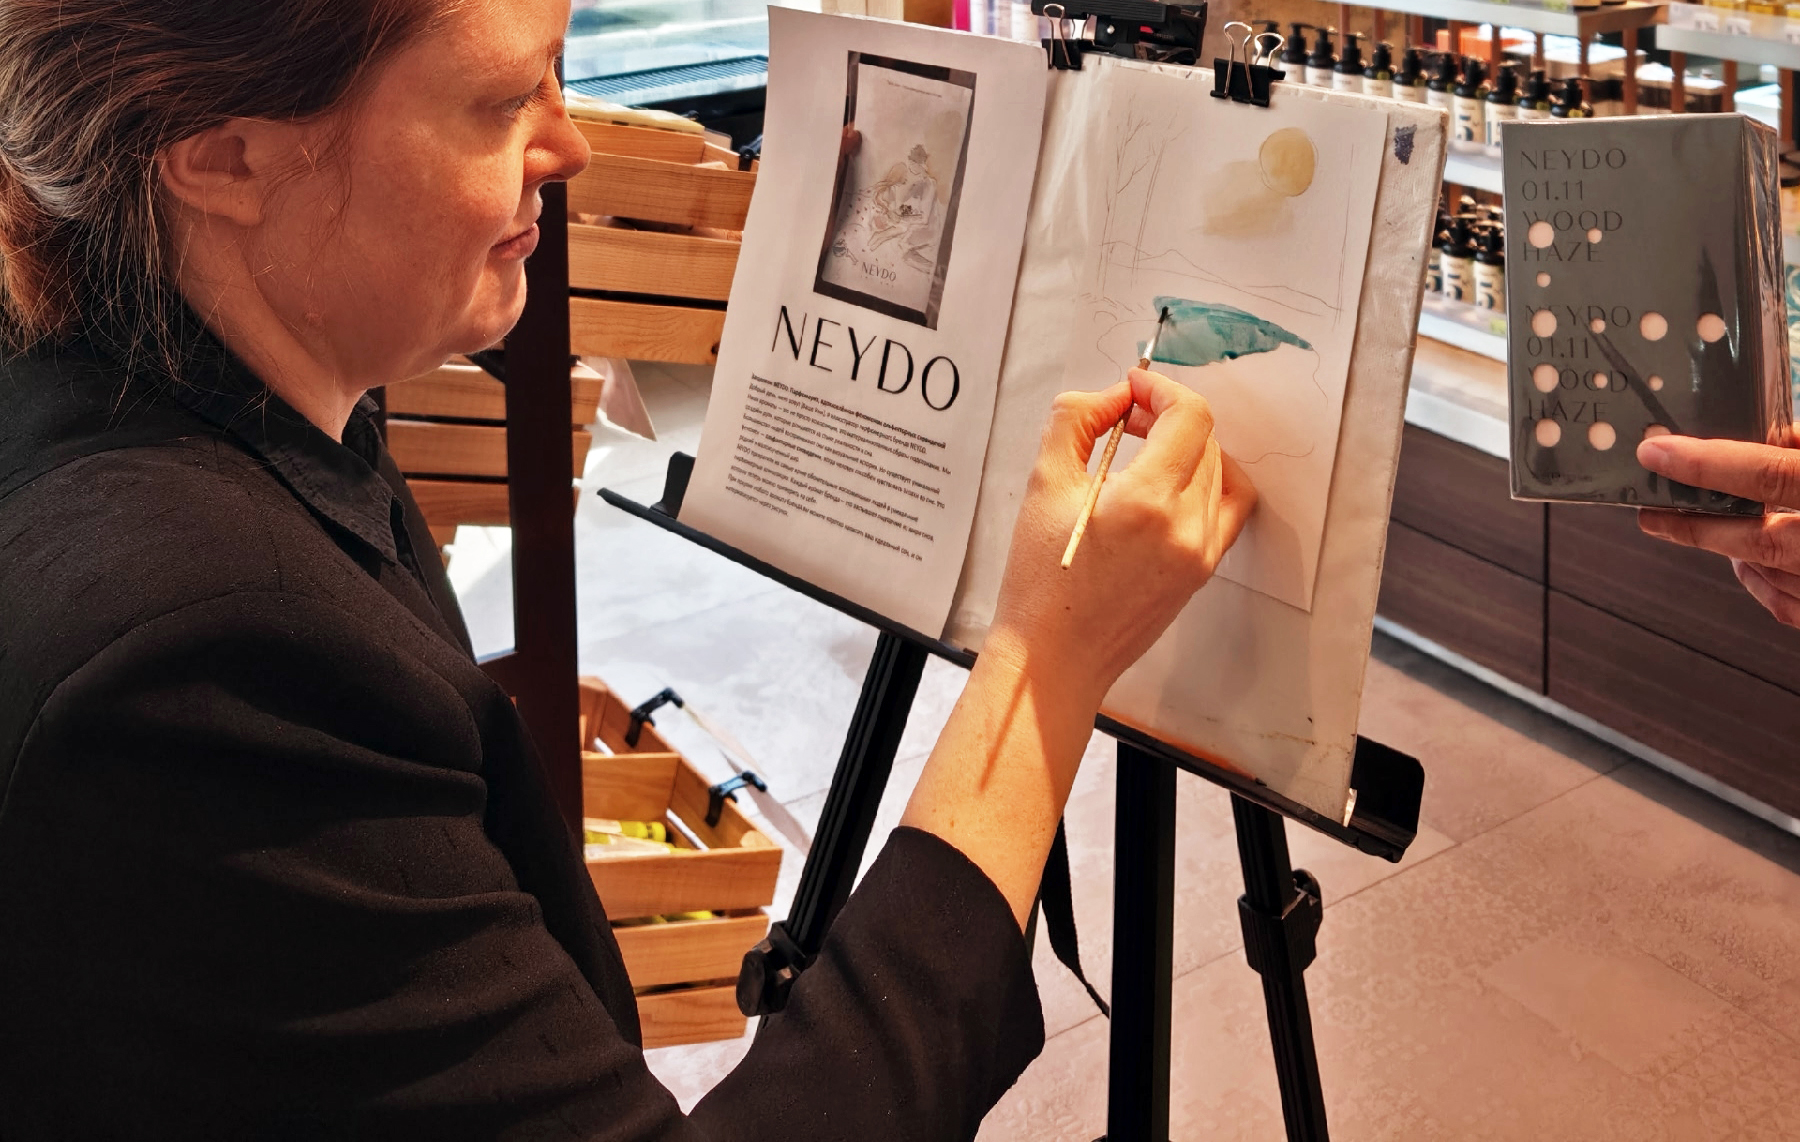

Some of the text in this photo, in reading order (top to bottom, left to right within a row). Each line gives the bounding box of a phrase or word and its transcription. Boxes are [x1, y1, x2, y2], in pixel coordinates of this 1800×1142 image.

[1520, 148, 1627, 171] NEYDO
[1521, 179, 1584, 202] 01.11
[1523, 241, 1605, 263] HAZE
[862, 261, 897, 282] NEYDO
[771, 305, 960, 412] NEYDO
[1527, 336, 1589, 359] 01.11
[1529, 398, 1608, 423] HAZE
